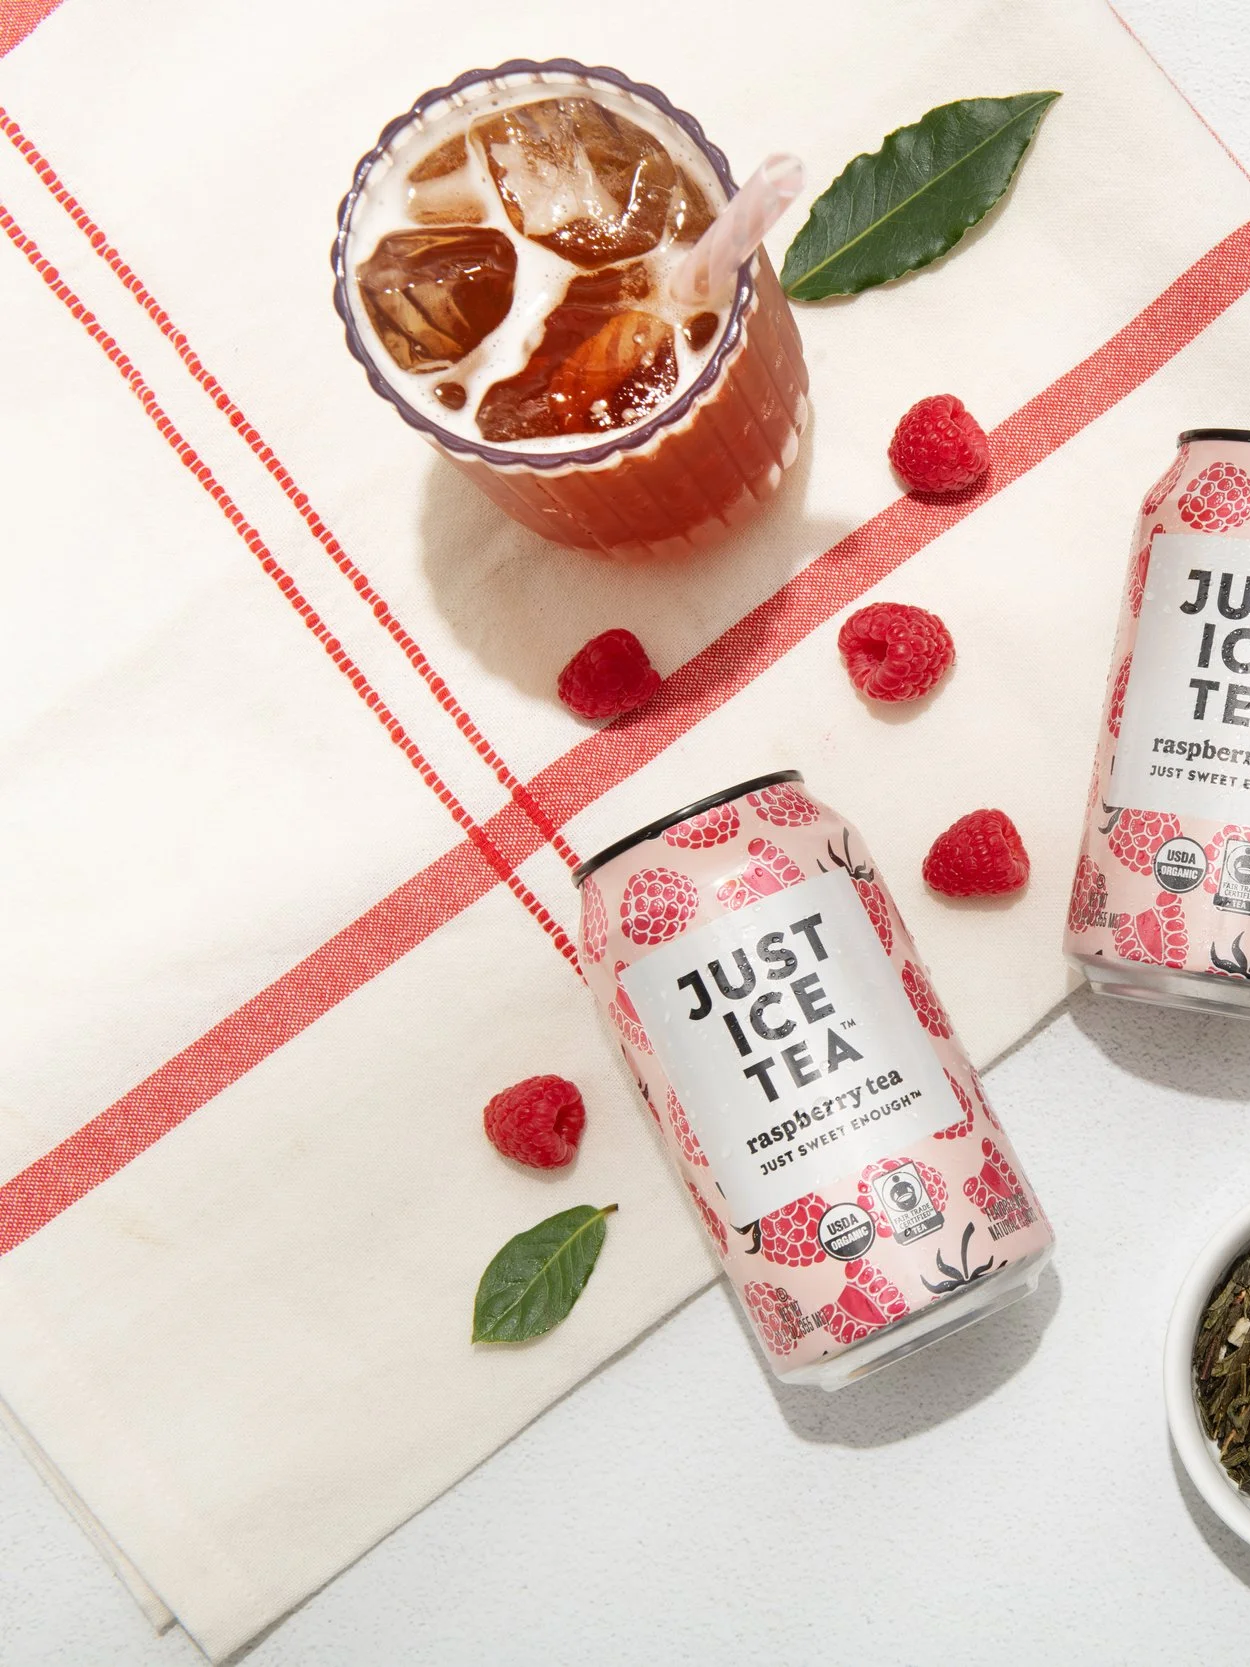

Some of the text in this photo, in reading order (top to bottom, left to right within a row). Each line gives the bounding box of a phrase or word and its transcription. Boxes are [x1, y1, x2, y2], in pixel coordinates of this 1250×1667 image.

[1150, 765, 1184, 779] JUST
[1187, 770, 1238, 788] SWEET
[1167, 849, 1196, 865] USDA
[1160, 865, 1198, 880] ORGANIC
[1222, 882, 1239, 891] FAIR
[1232, 899, 1247, 910] TEA
[676, 912, 829, 1021] JUST
[722, 971, 836, 1057] ICE
[746, 1069, 904, 1154] raspberry tea
[760, 1151, 794, 1175] JUST
[797, 1125, 846, 1157] SWEET
[826, 1213, 859, 1236] USDA
[894, 1202, 932, 1225] FAIR TRADE
[831, 1225, 869, 1251] ORGANIC
[911, 1224, 928, 1235] TEA
[987, 1214, 1021, 1241] NATURAL
